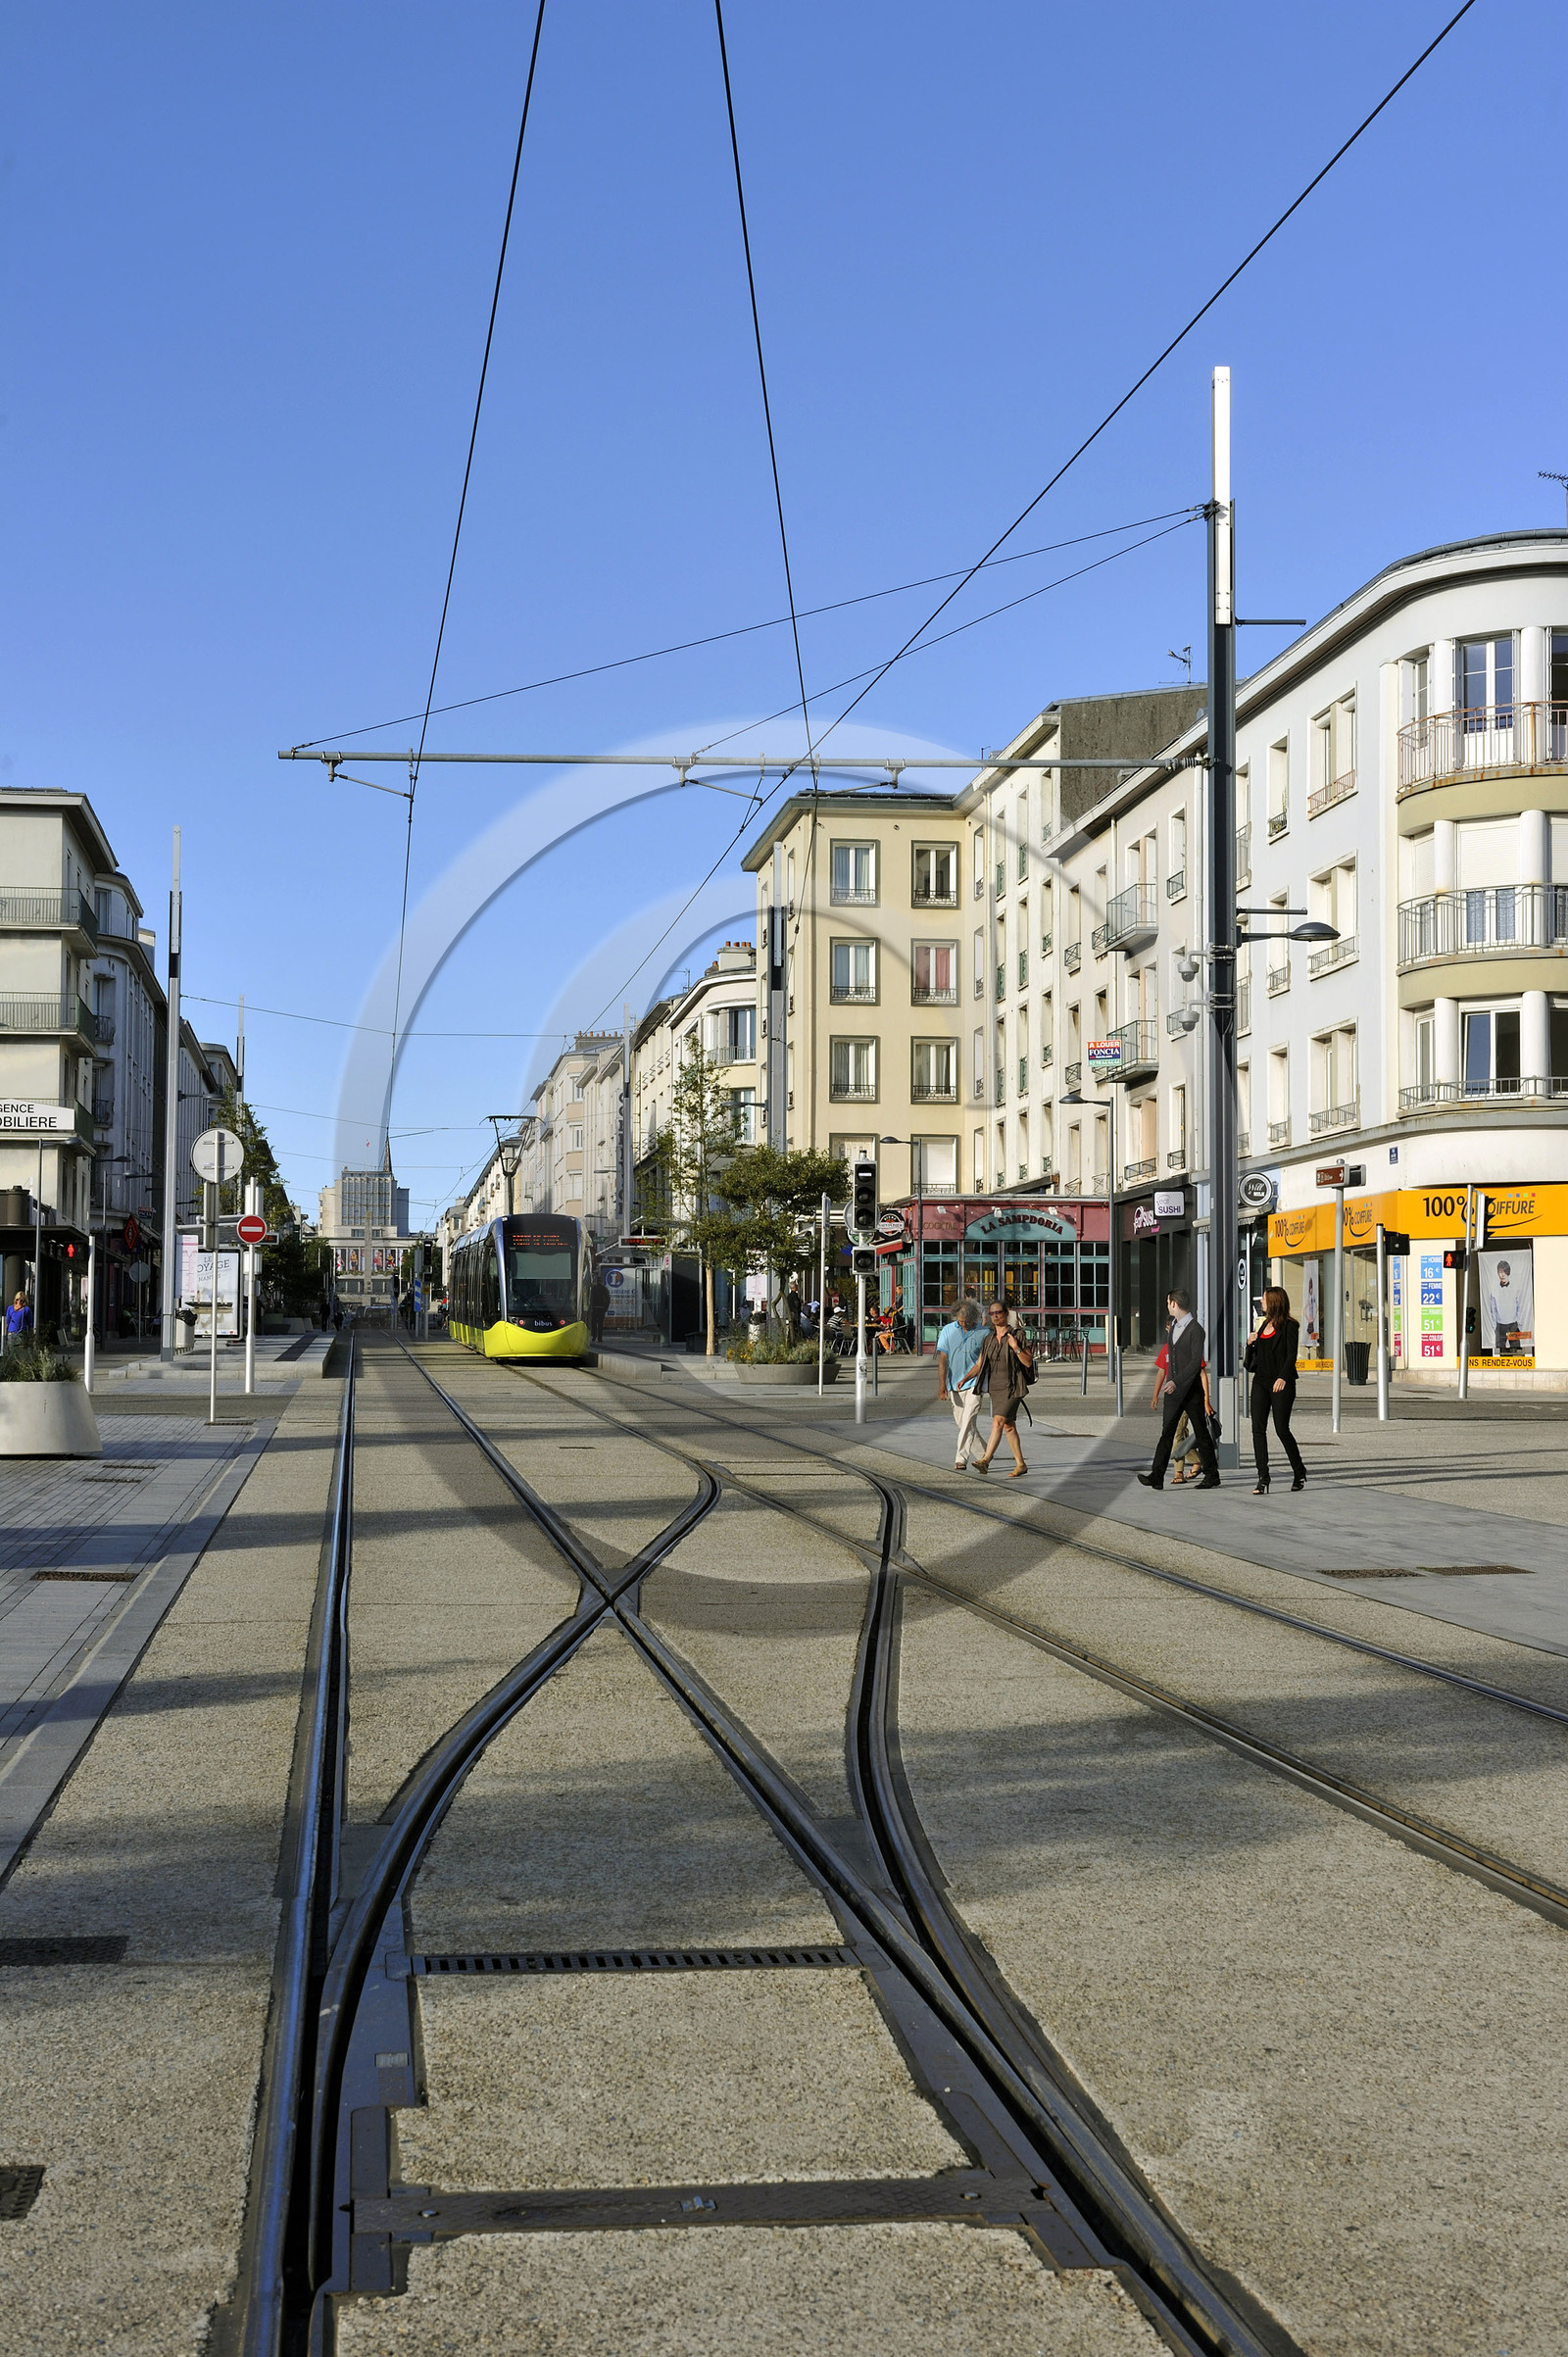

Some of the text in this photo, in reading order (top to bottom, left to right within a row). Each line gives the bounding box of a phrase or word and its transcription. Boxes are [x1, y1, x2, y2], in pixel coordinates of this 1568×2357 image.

[1158, 1205, 1181, 1214] SUSHI
[1487, 1200, 1536, 1215] OIFFURE
[980, 1214, 1064, 1236] LA SAMPDORIA
[1423, 1267, 1434, 1279] 16
[1423, 1293, 1436, 1304] 22
[1424, 1319, 1435, 1331] 51
[1424, 1345, 1435, 1356] 51
[1468, 1358, 1533, 1367] NS RENDEZ-VOUS
